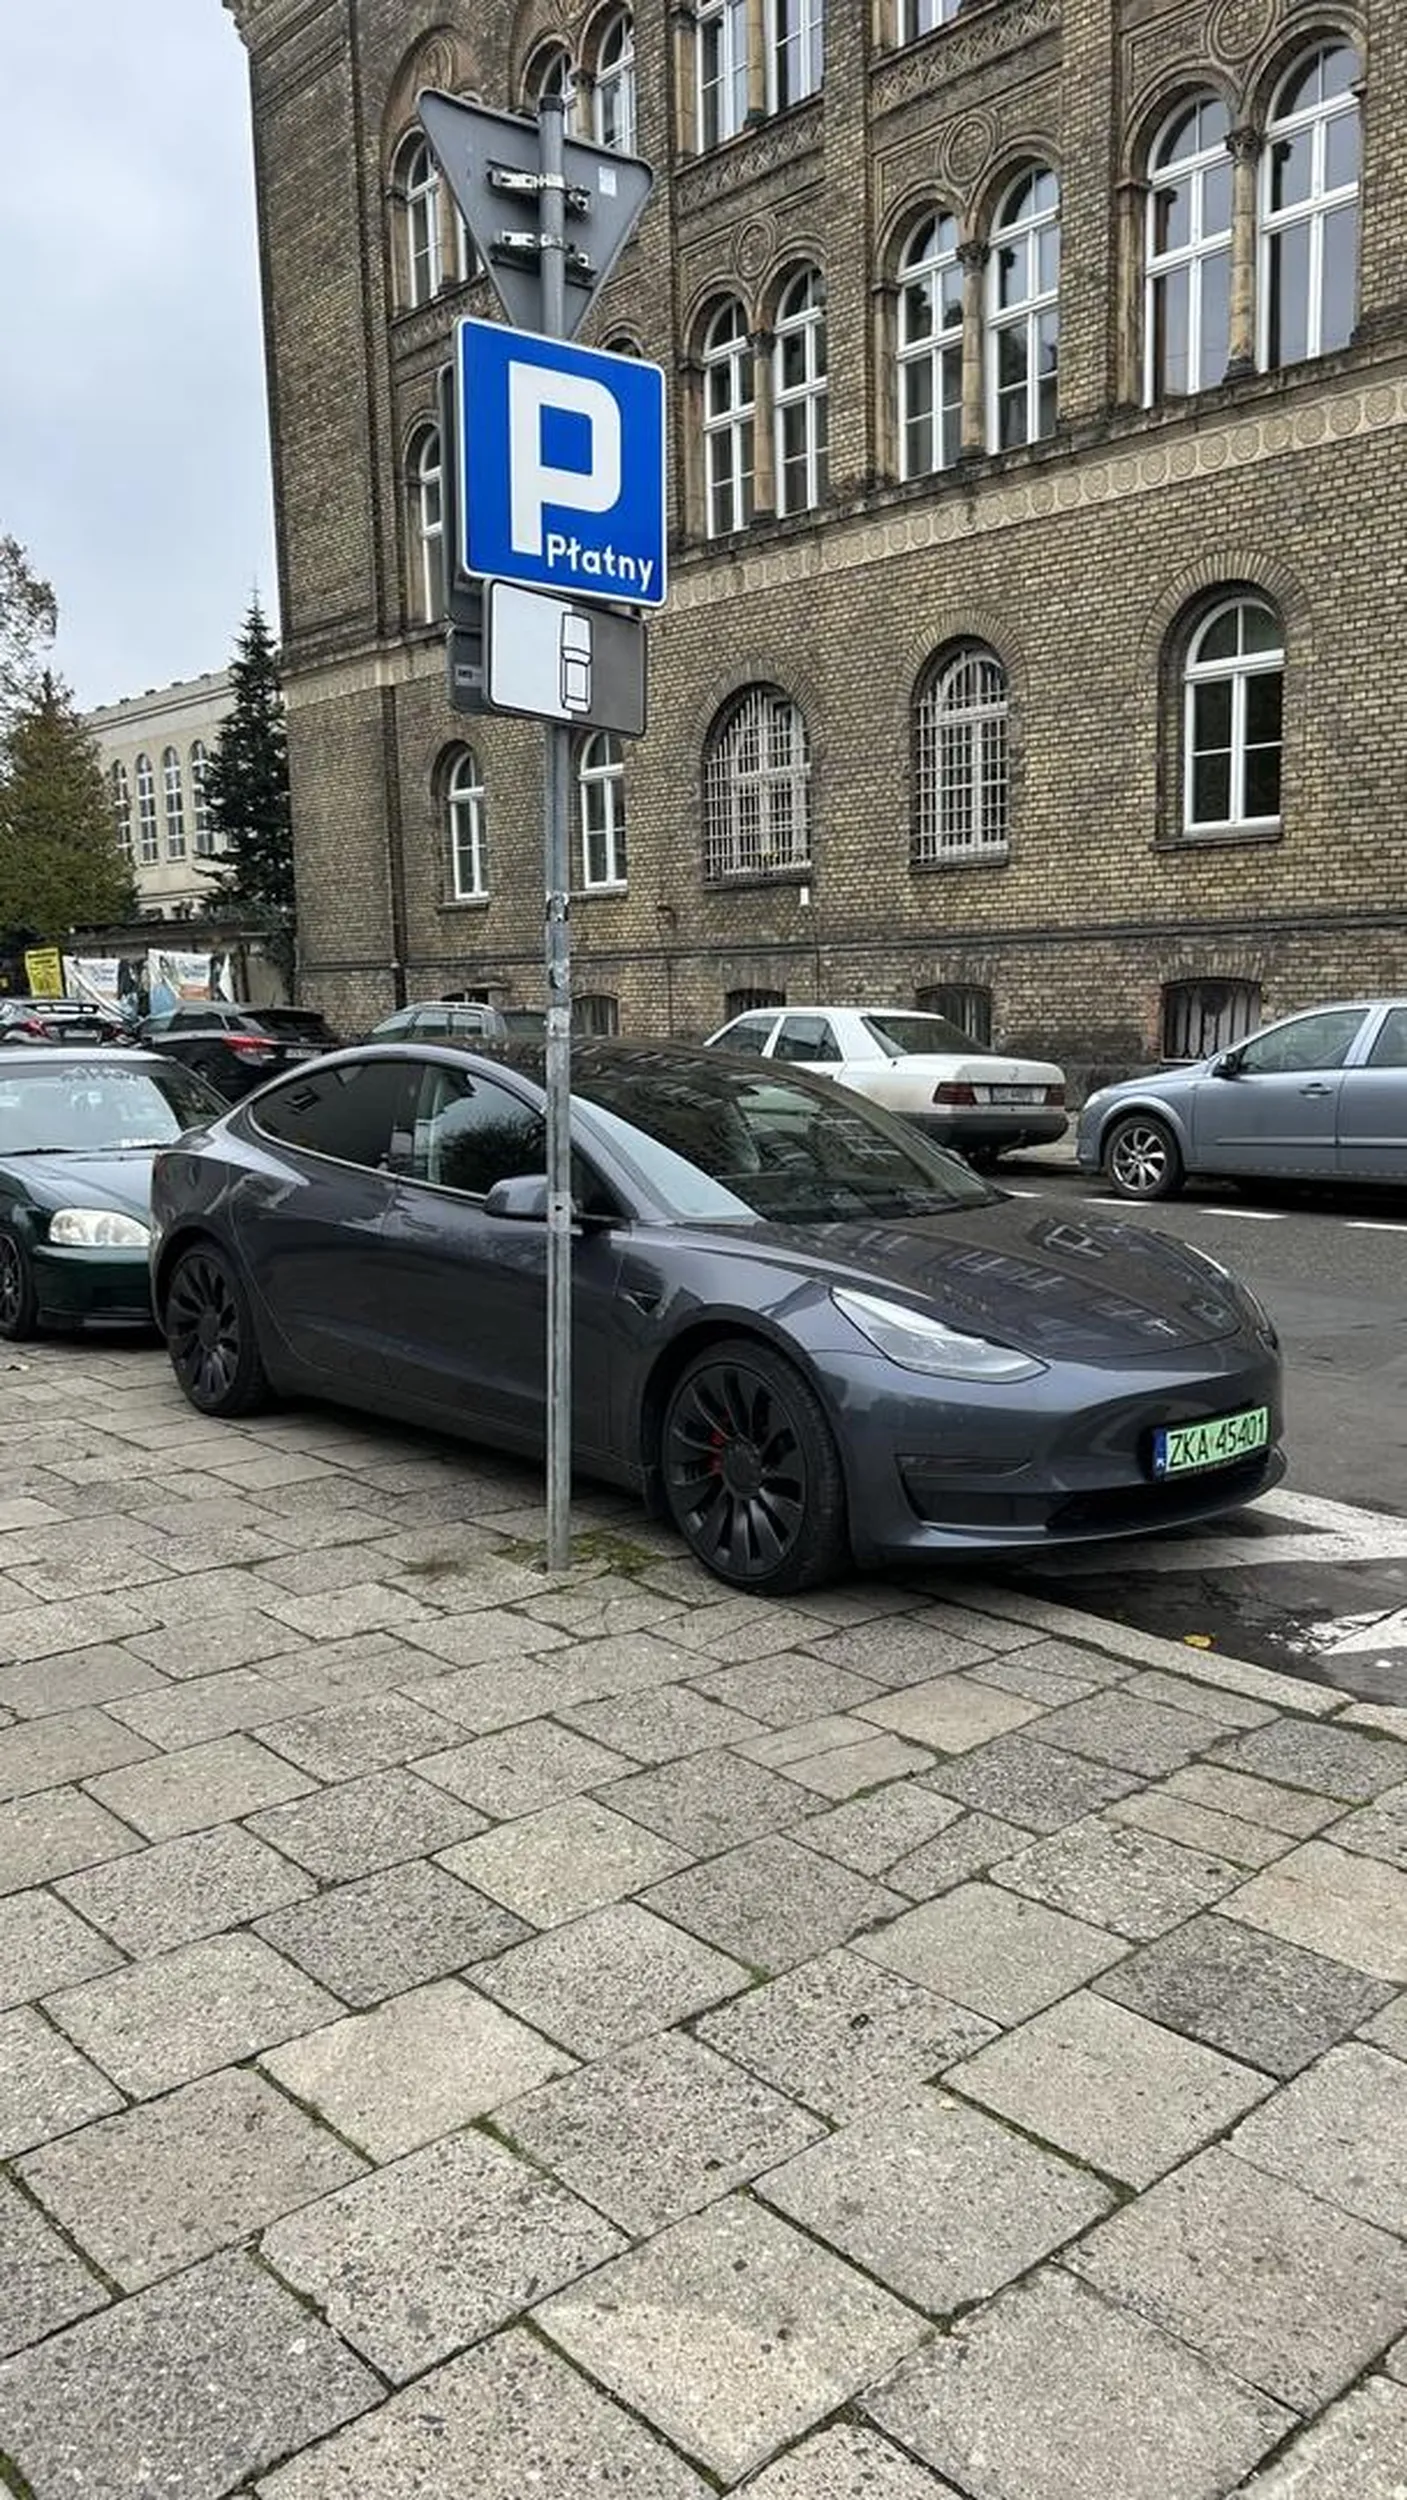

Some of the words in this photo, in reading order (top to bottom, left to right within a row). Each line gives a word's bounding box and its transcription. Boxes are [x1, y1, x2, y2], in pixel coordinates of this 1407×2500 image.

[508, 360, 621, 556] P
[547, 534, 654, 593] Płatny
[1170, 1429, 1209, 1467] ZKA
[1216, 1411, 1264, 1455] 45401
